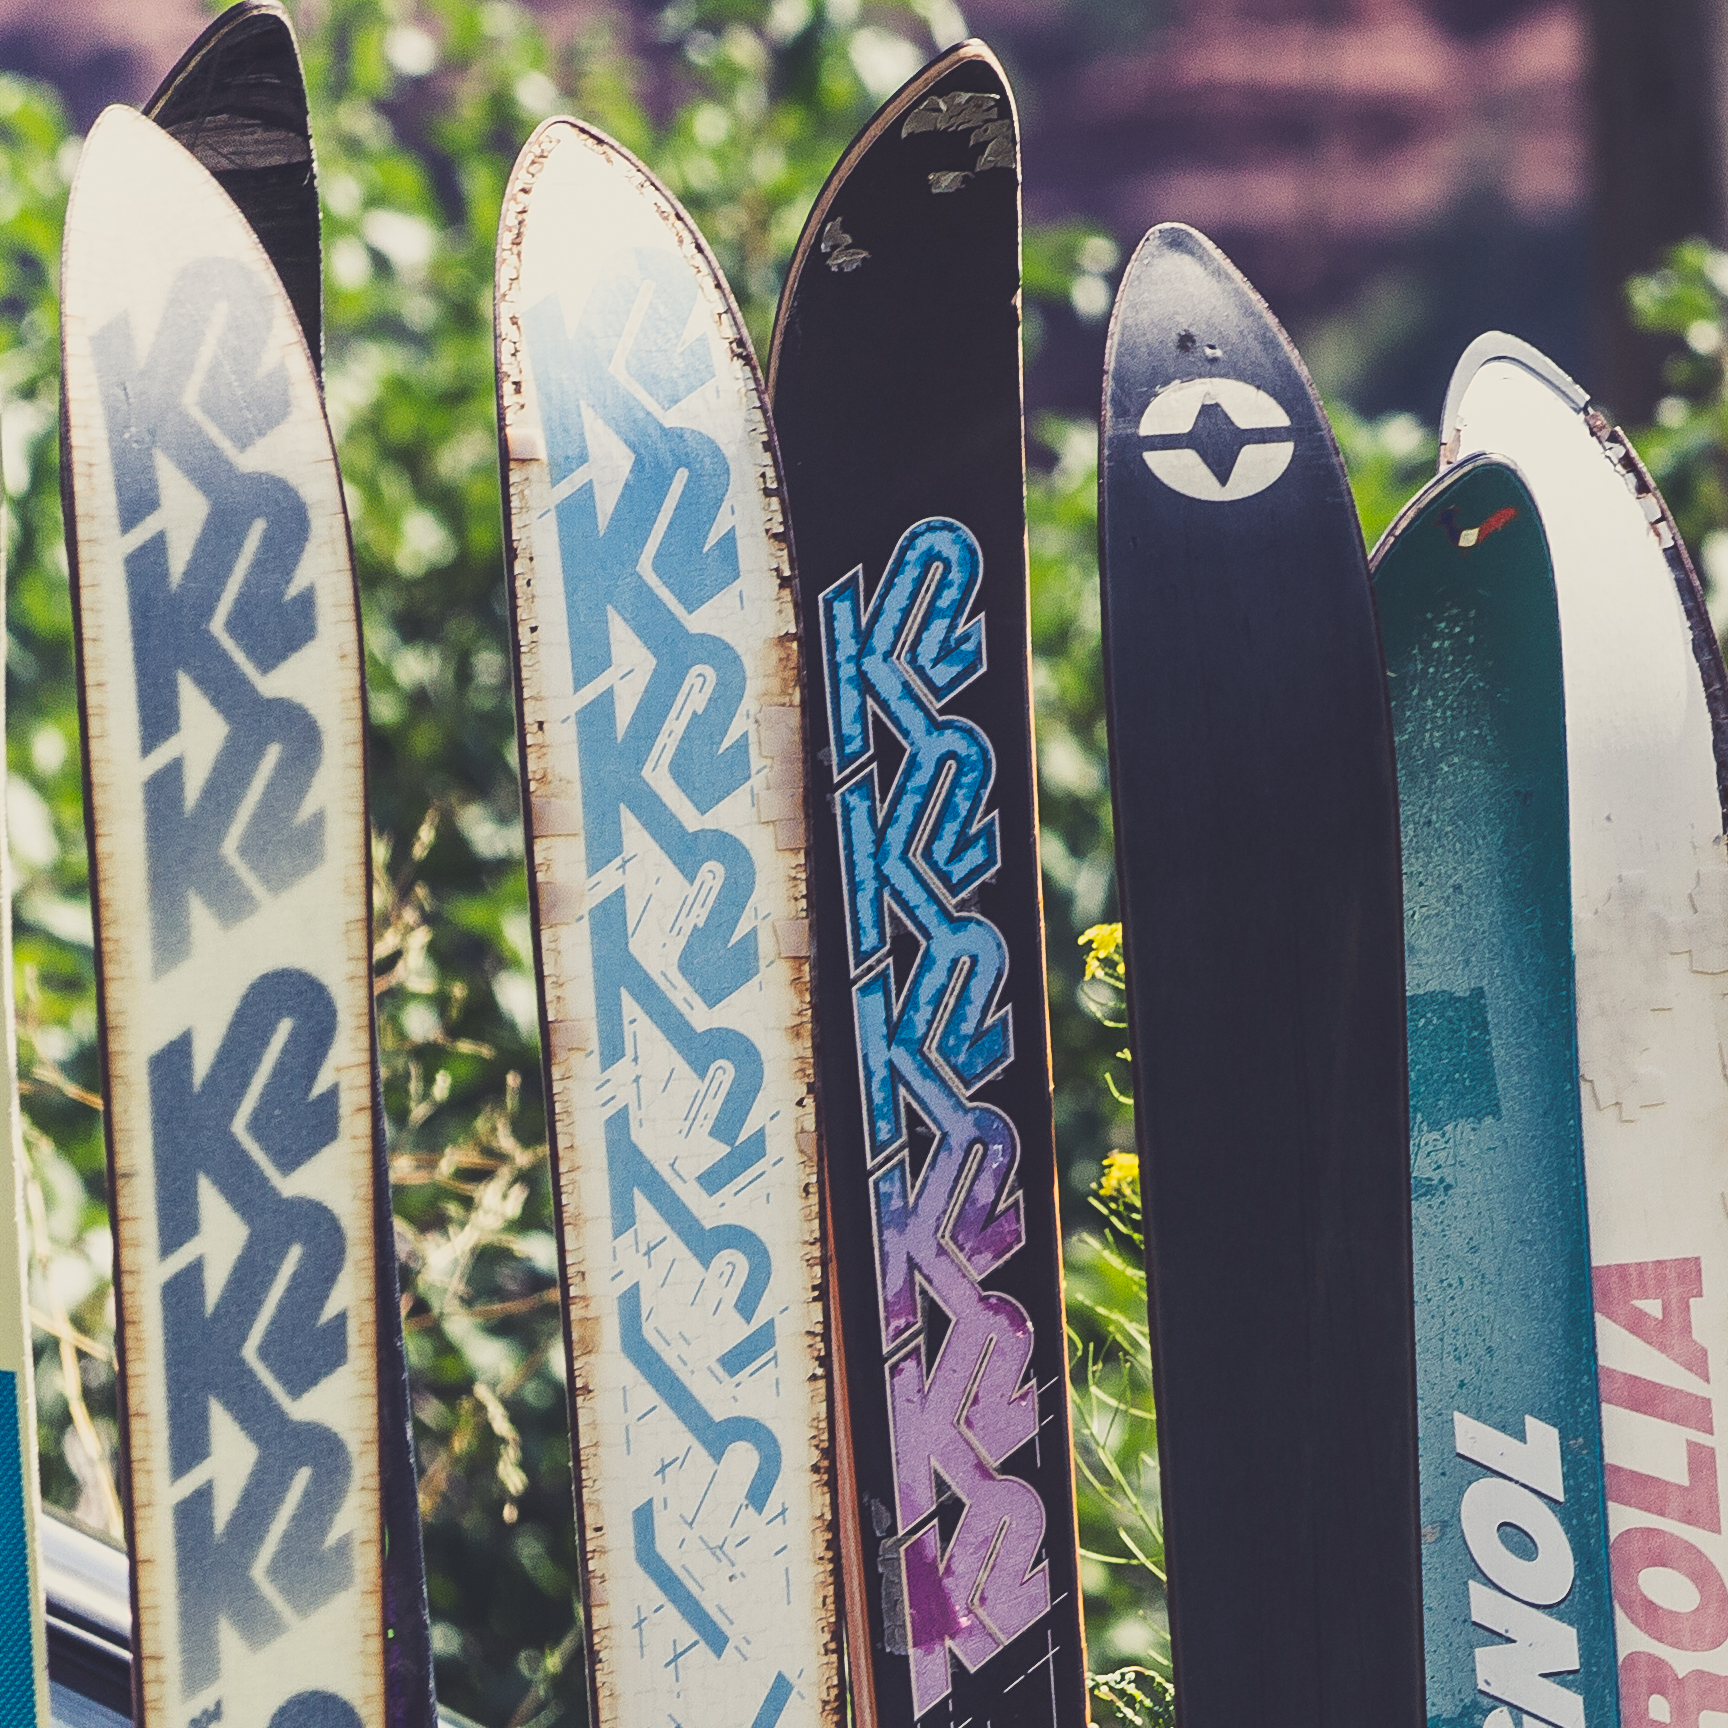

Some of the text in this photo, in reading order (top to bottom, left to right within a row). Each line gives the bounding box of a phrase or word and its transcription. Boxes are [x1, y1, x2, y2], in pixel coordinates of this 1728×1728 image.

[89, 254, 298, 535] K2
[123, 471, 318, 762] K2
[817, 515, 987, 785] K2
[142, 696, 327, 982] K2
[832, 715, 1002, 982] K2
[147, 966, 341, 1262] K2
[851, 910, 1016, 1170] K2
[160, 1195, 348, 1485] K2
[868, 1101, 1026, 1358] K2
[884, 1290, 1039, 1542] K2
[171, 1419, 354, 1702] K2
[897, 1473, 1051, 1720] K2
